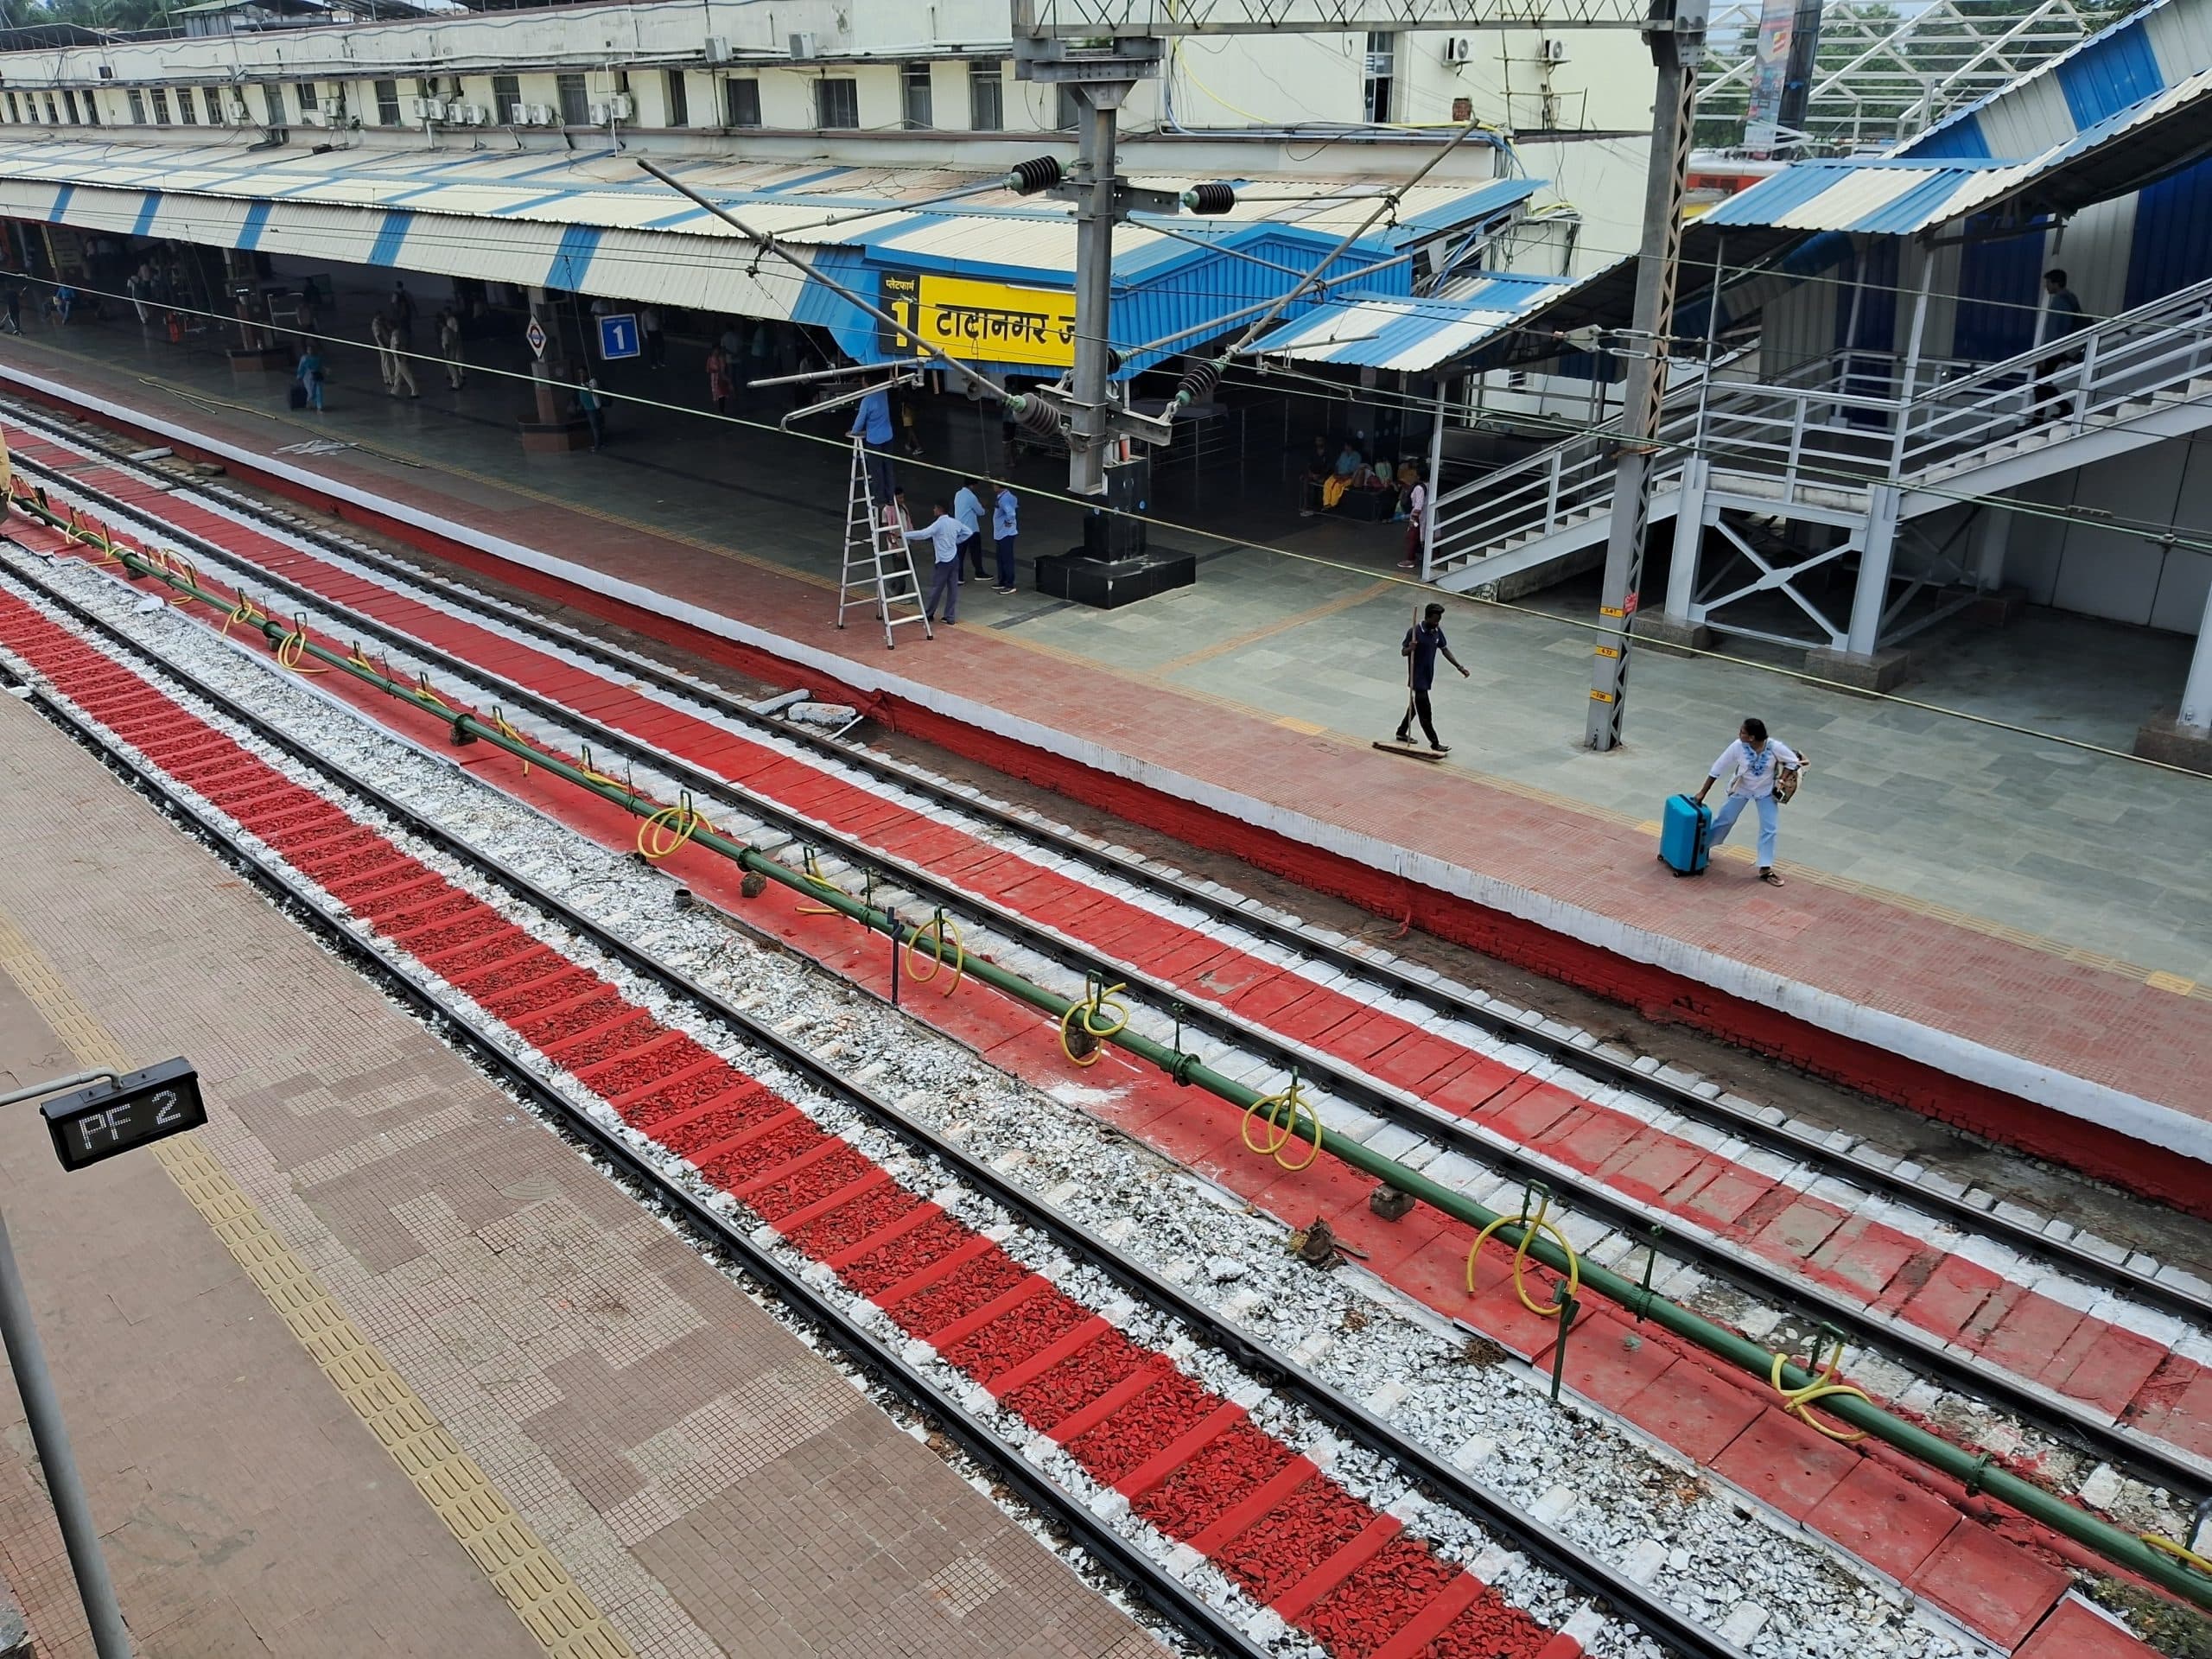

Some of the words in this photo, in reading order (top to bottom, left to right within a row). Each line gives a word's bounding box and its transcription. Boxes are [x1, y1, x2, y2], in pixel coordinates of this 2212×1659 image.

[885, 277, 915, 291] प्लेटफार्म
[613, 324, 625, 350] 1
[891, 302, 909, 346] 1
[936, 303, 1049, 344] टाटानगर
[79, 1103, 131, 1150] PF
[151, 1090, 181, 1125] 2
